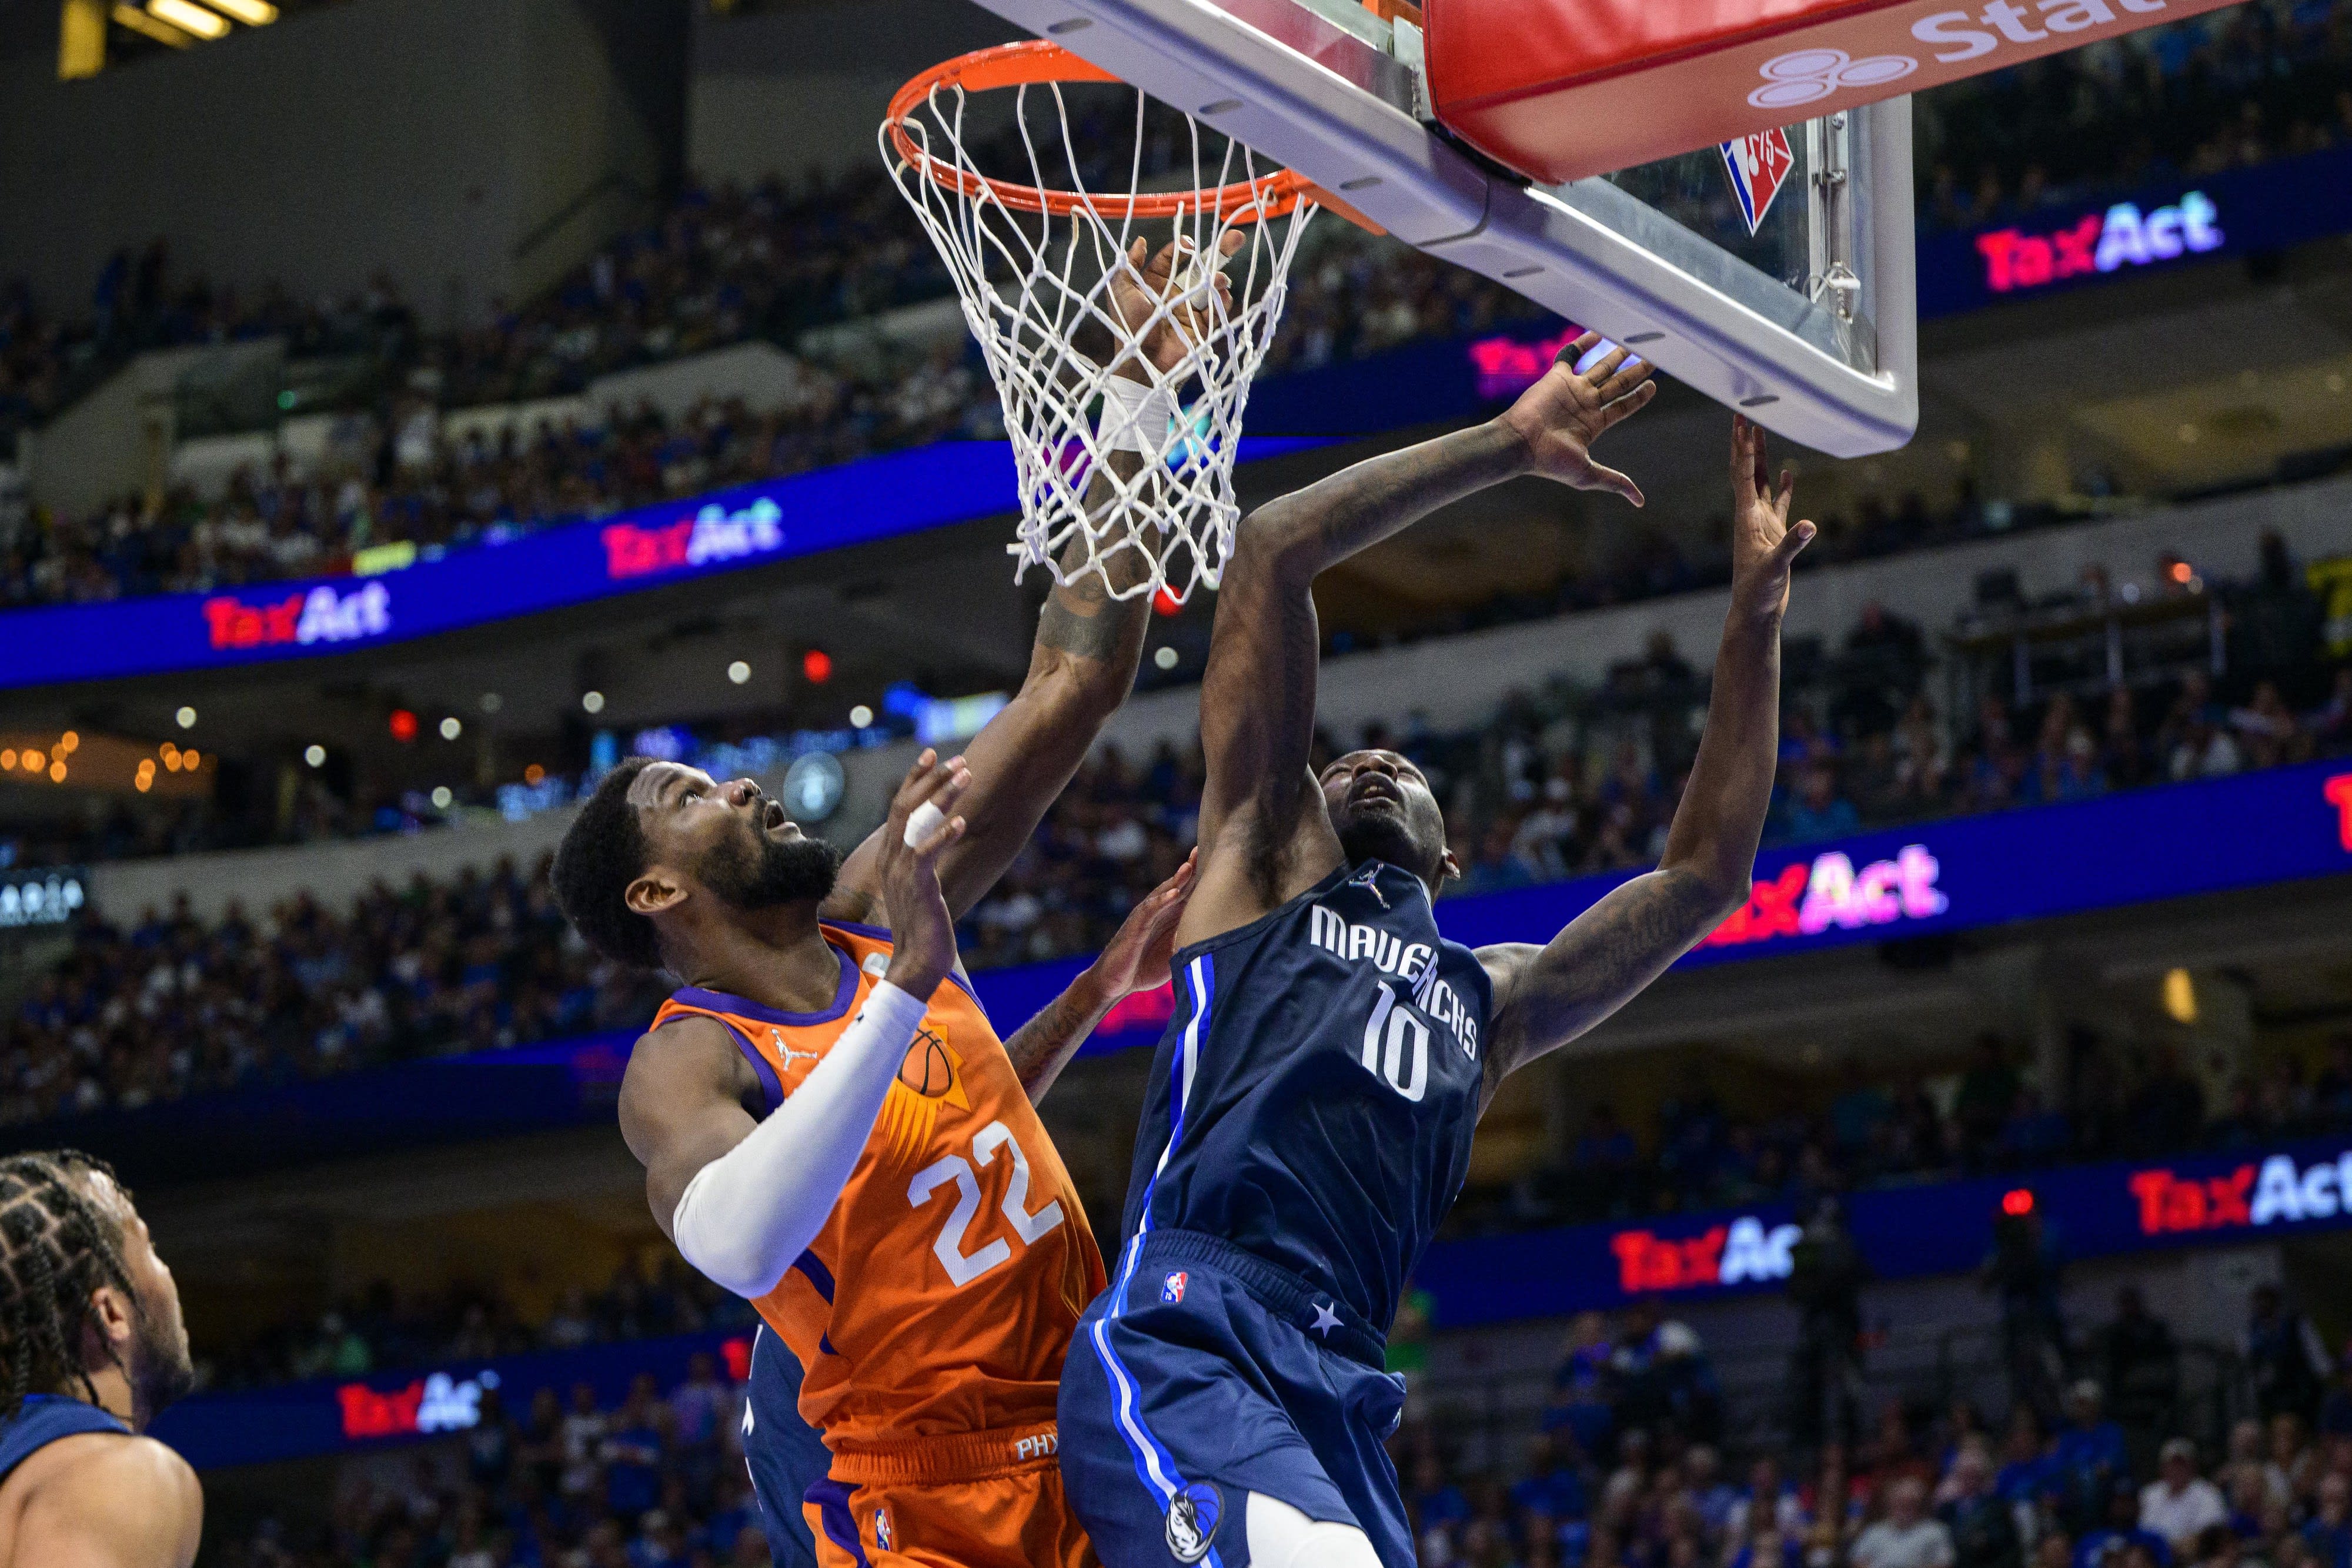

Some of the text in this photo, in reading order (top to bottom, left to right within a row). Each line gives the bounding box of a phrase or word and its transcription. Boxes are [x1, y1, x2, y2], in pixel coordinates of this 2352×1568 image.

[1976, 191, 2225, 290] TaxAct
[602, 498, 786, 579] TaxAct
[204, 581, 393, 649] TaxAct
[1362, 979, 1430, 1102] 10
[907, 1120, 1065, 1289] 22
[1612, 1216, 1804, 1292] TaxAc
[337, 1370, 500, 1437] TaxAc
